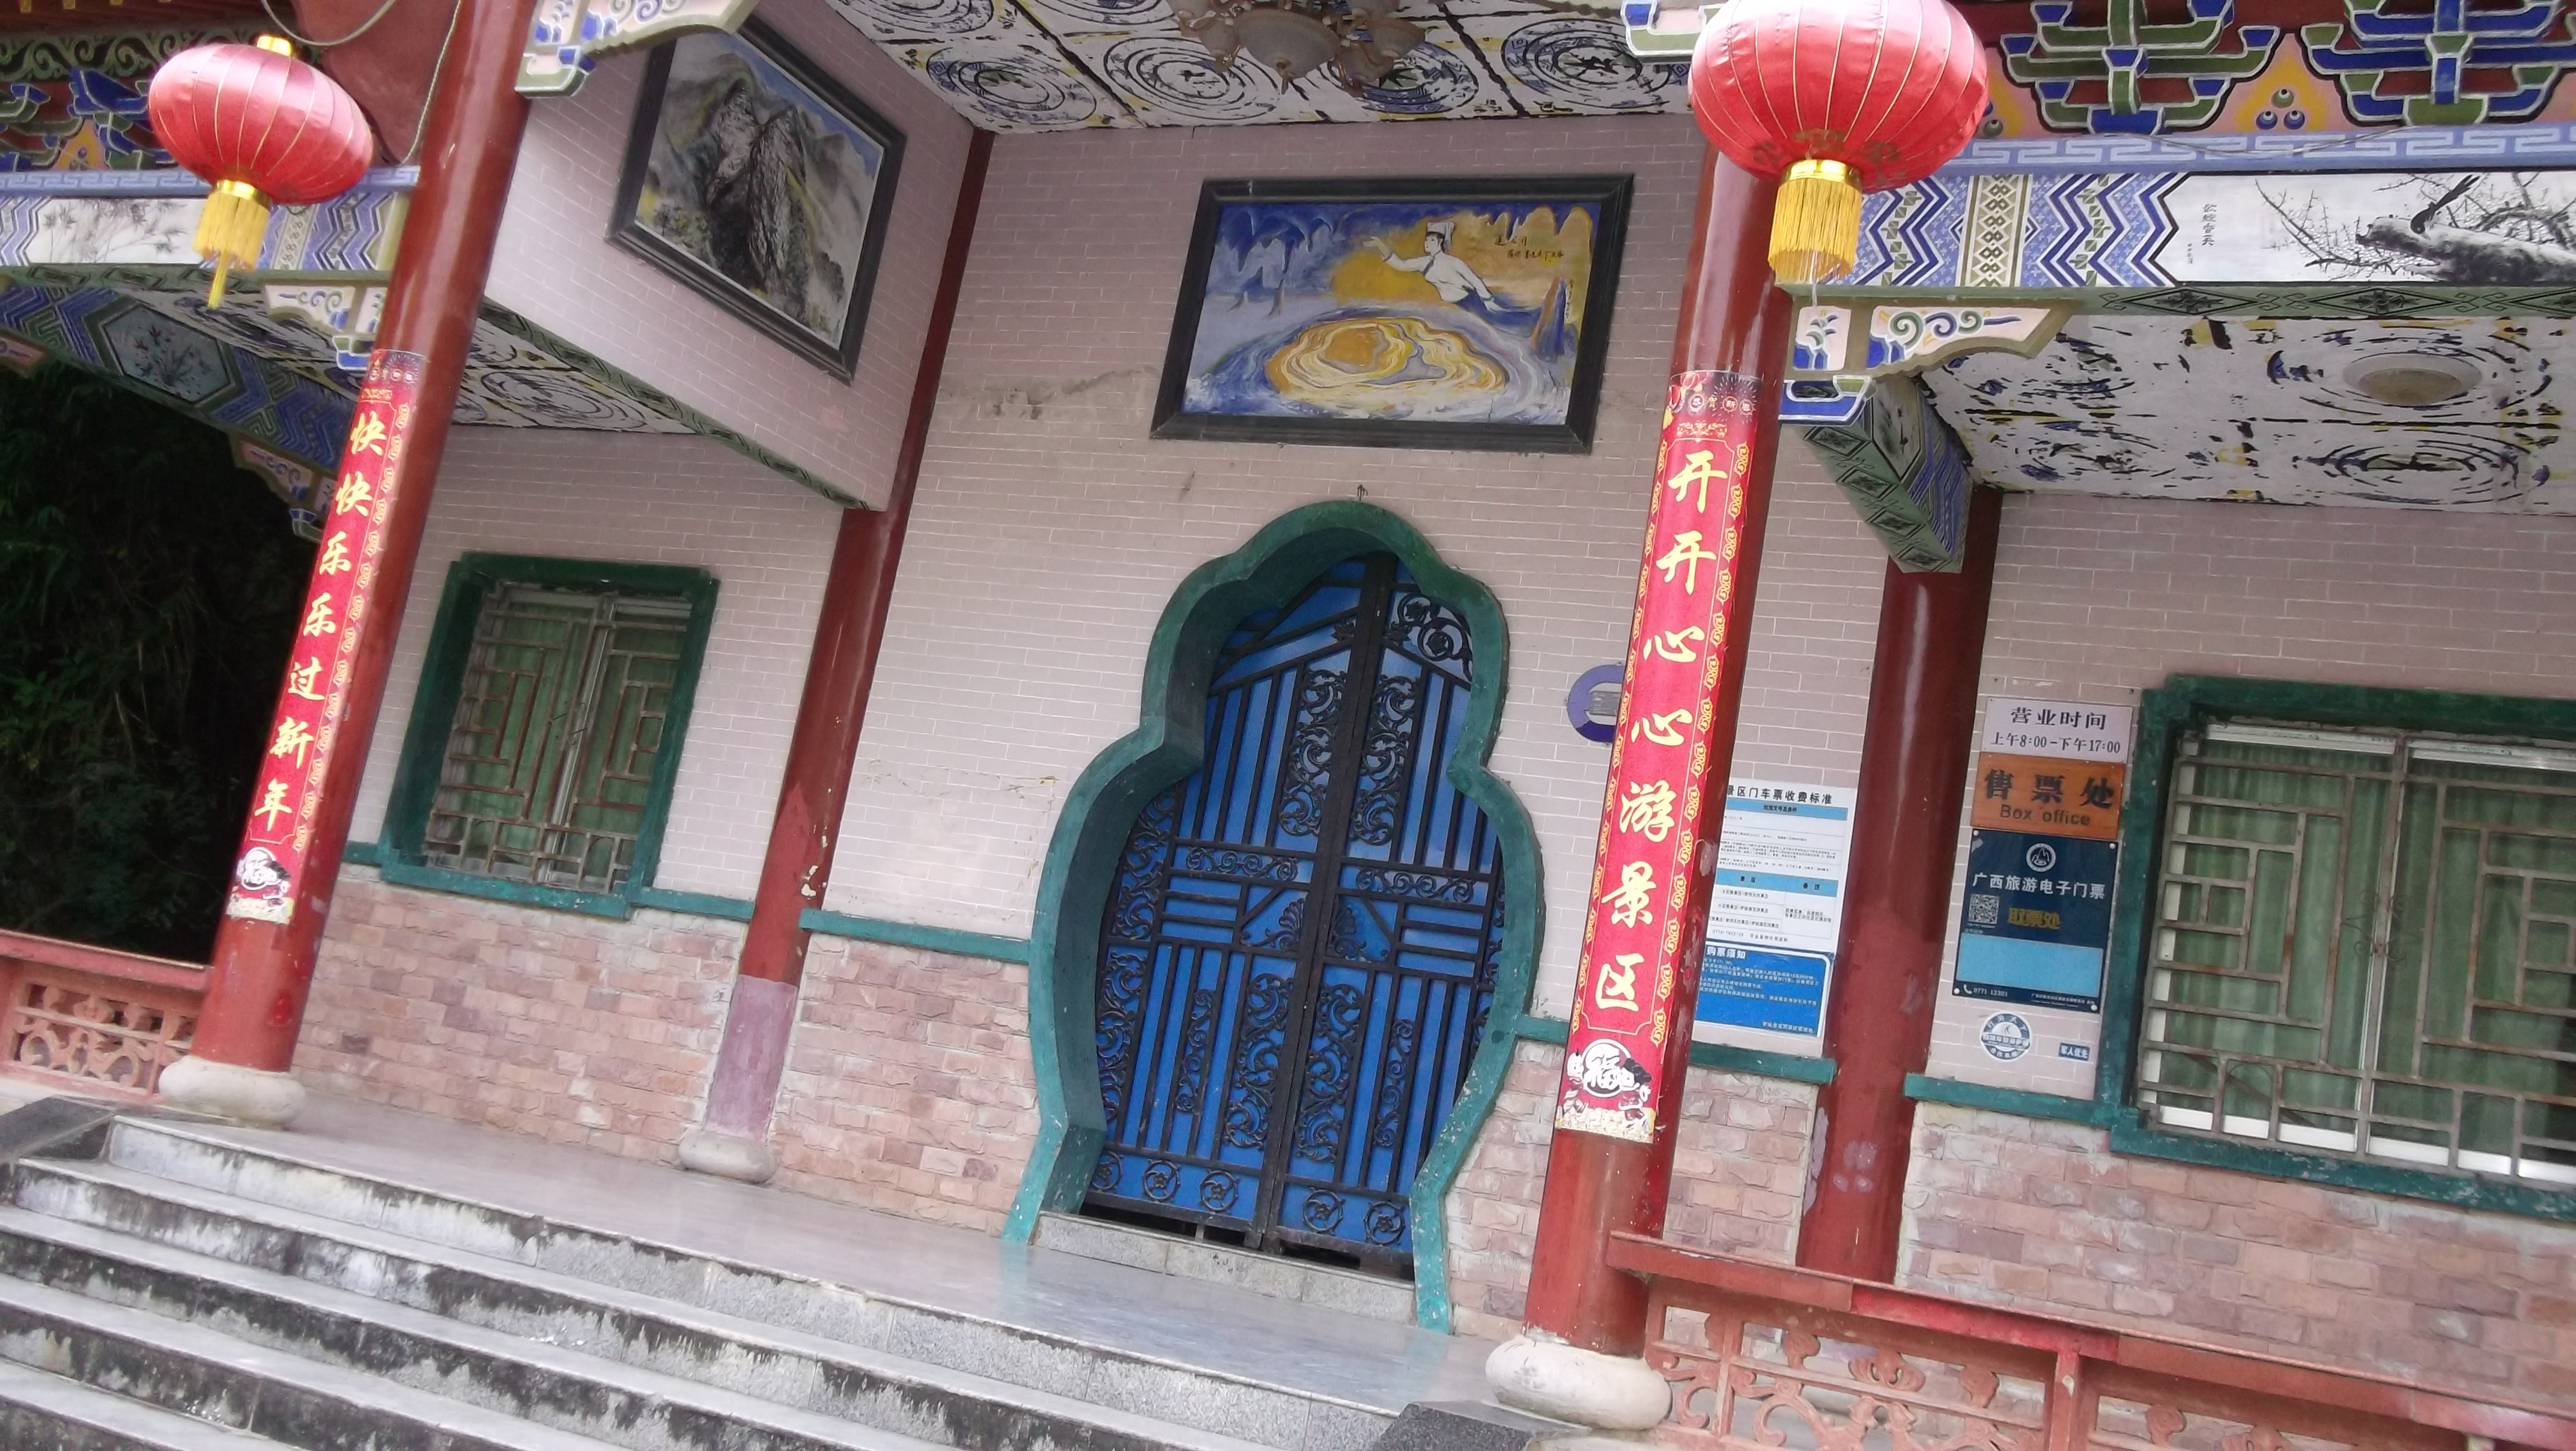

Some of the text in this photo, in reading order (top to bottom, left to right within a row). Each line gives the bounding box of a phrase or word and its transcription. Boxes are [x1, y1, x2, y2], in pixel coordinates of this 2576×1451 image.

[255, 411, 387, 831] 快快乐乐过新年
[2010, 707, 2107, 730] 营业时间
[1596, 450, 1727, 1011] 开开心心游景区
[1984, 768, 2115, 809] 售票处
[2000, 804, 2091, 826] Box office
[1972, 871, 2106, 900] 广西旅游电子门票
[2007, 907, 2061, 930] 取票处
[1707, 947, 1746, 959] 购票须知
[2061, 1046, 2089, 1059] 军人优先
